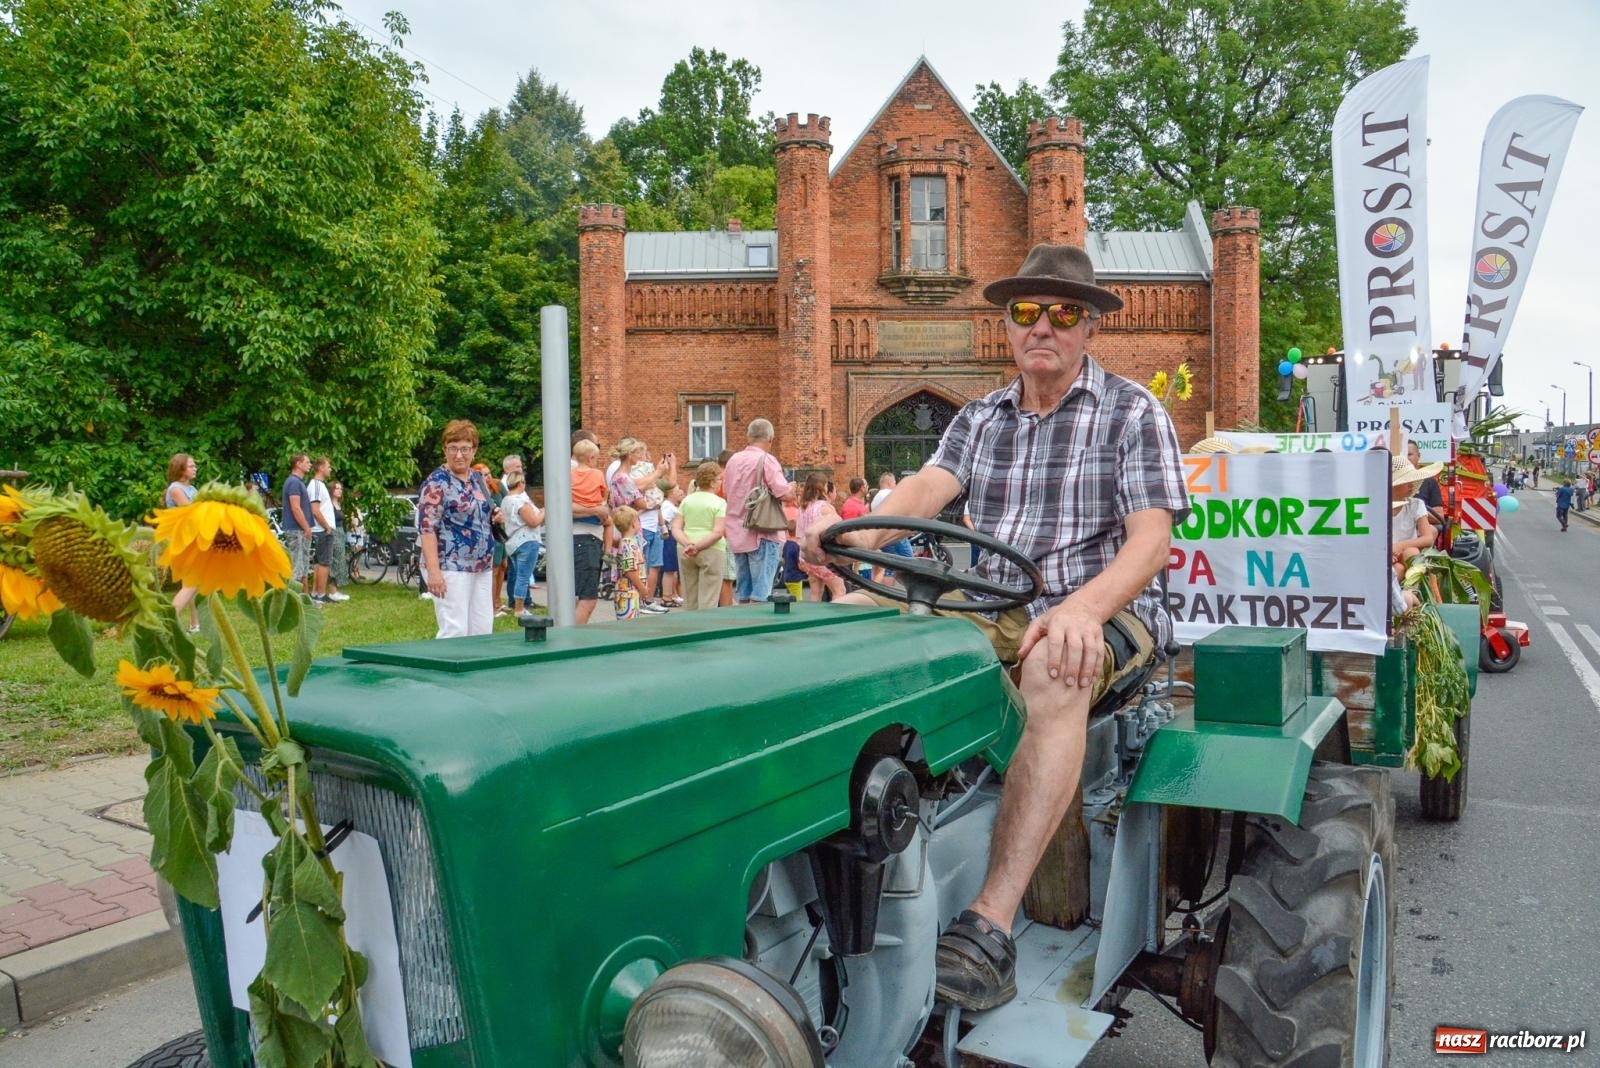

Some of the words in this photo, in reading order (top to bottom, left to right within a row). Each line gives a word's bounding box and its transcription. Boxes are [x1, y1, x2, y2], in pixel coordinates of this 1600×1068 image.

[1362, 111, 1417, 341] PROSAT
[1246, 550, 1310, 588] NA
[1168, 592, 1366, 630] RAKTORZE
